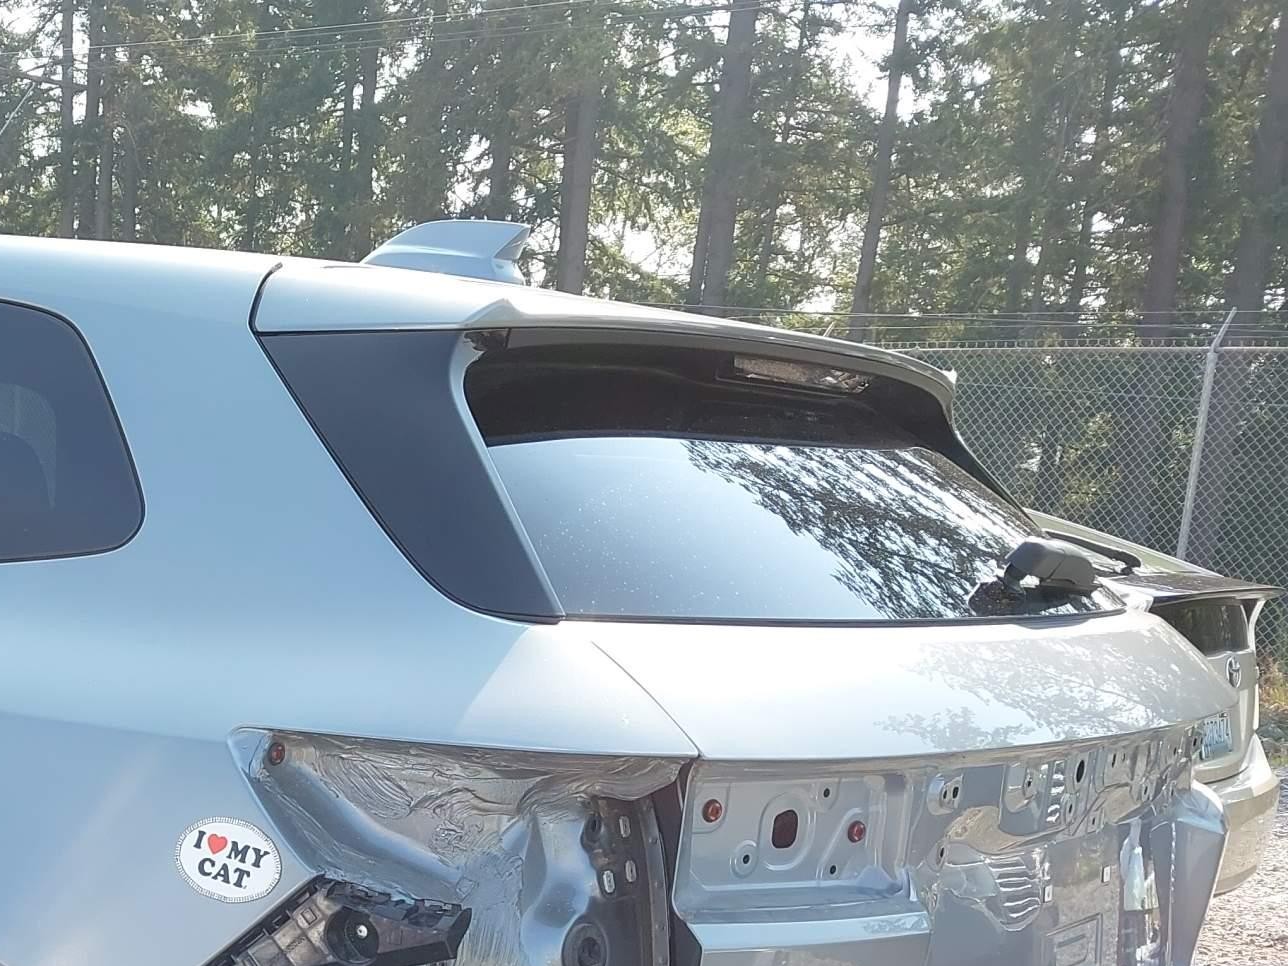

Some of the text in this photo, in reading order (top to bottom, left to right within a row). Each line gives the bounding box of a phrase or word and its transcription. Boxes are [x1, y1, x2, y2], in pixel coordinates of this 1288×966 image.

[193, 830, 270, 868] I MY
[198, 858, 250, 888] CAT
